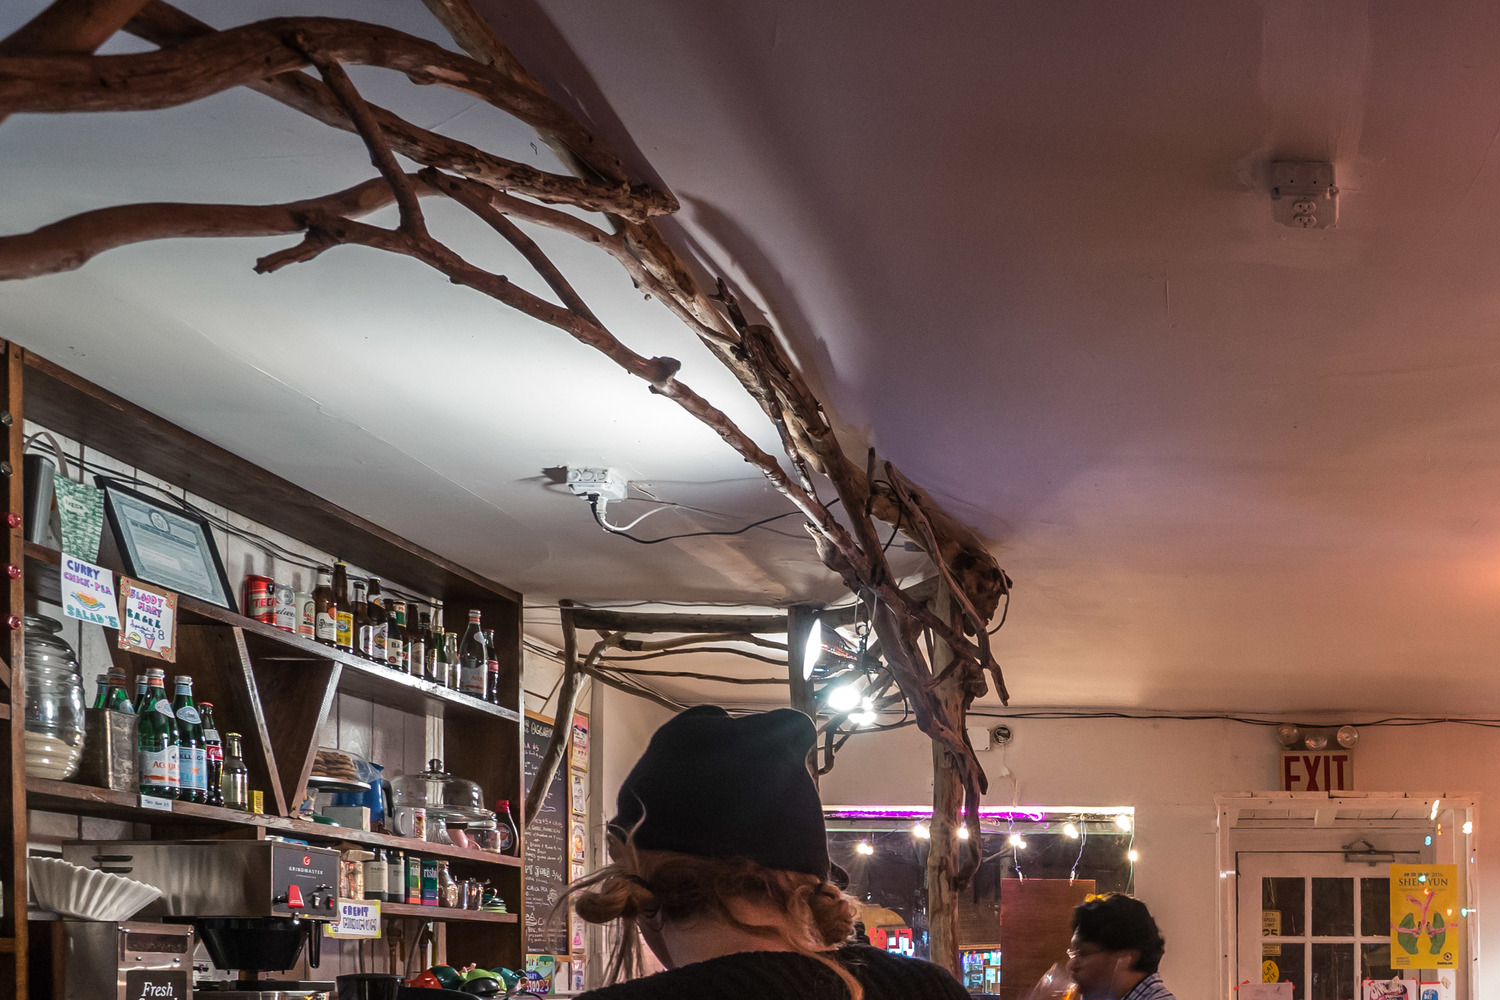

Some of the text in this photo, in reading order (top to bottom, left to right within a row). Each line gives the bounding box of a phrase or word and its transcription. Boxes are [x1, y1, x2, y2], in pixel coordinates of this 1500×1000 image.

[66, 559, 101, 581] CURRY
[63, 571, 113, 596] CHICK-PEA
[129, 588, 163, 608] BLOODY
[66, 604, 105, 625] SALAD
[137, 601, 163, 618] MARY
[1284, 754, 1348, 792] EXIT
[288, 866, 324, 875] GRINDMASTER
[1427, 878, 1448, 887] YUN
[343, 905, 369, 918] CREDIT
[342, 917, 377, 931] MINIMUM
[141, 981, 174, 997] Fresh
